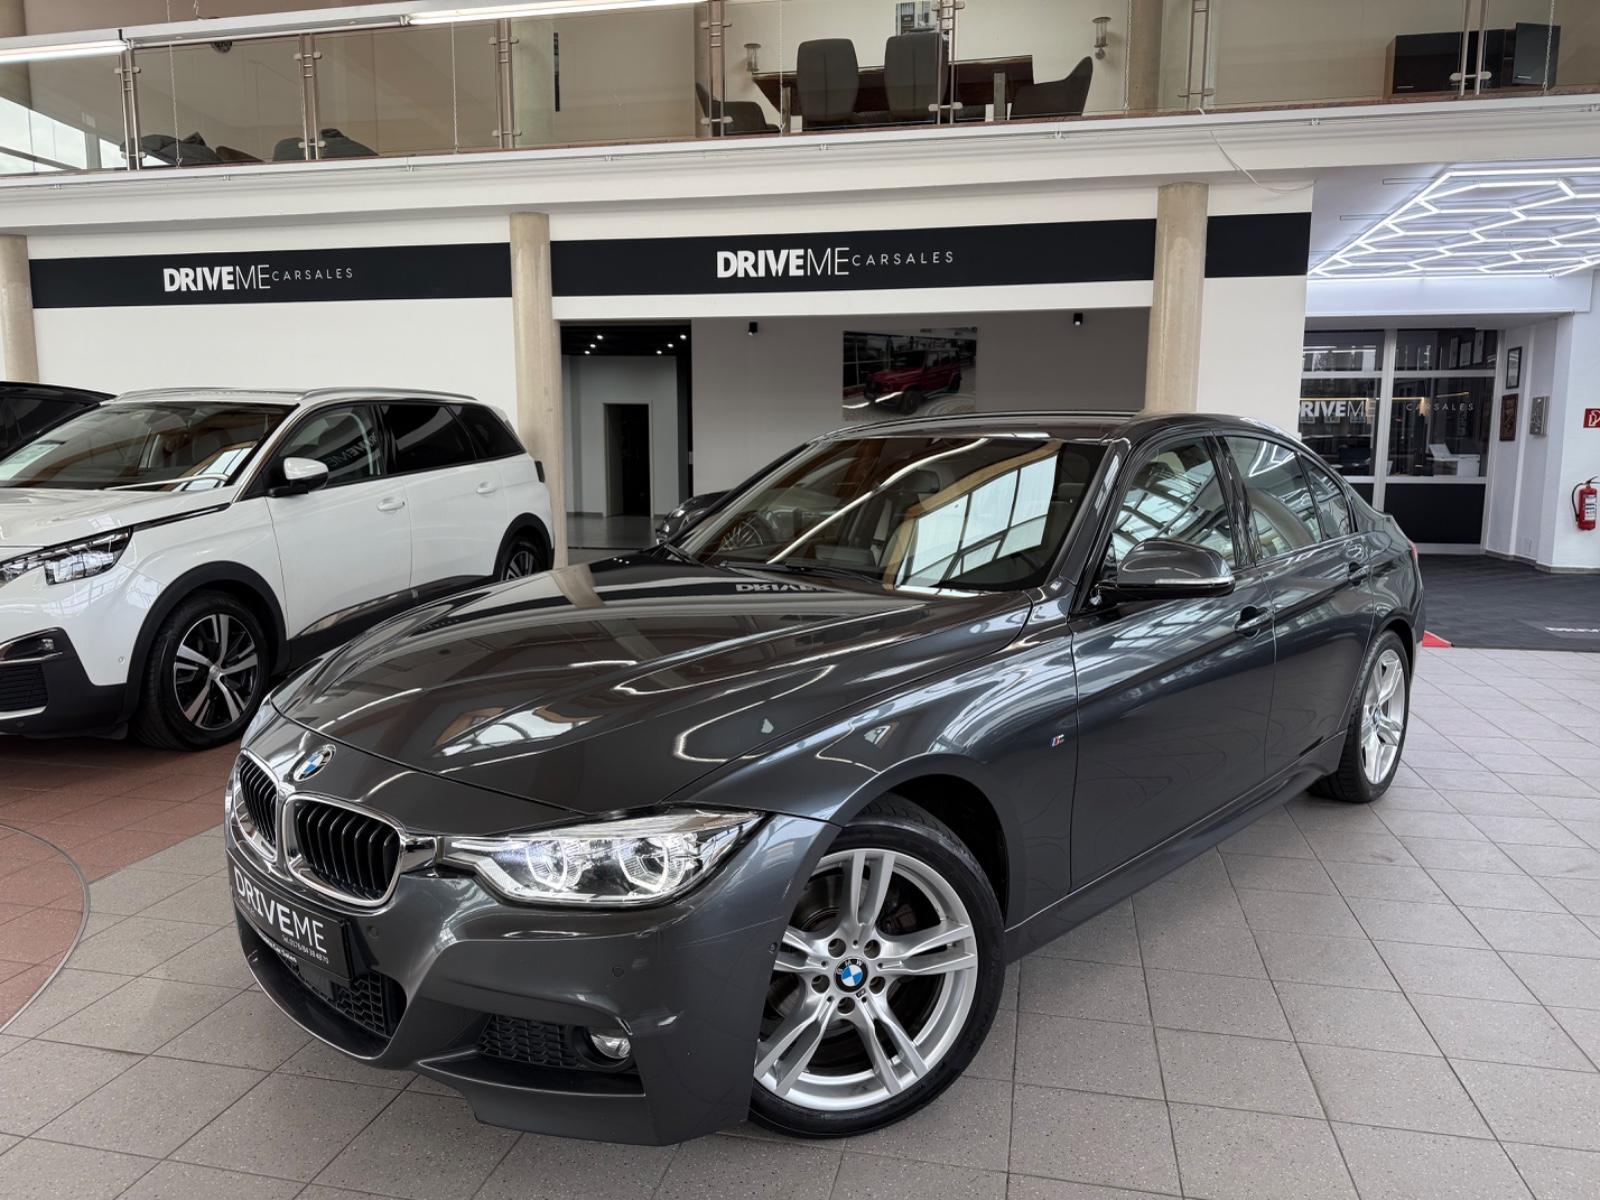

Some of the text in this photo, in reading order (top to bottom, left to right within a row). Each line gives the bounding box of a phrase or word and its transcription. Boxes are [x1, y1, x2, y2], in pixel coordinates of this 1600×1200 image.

[163, 264, 353, 292] DRIVEME CARSALES
[716, 247, 954, 278] DRIVEME CARSALES
[234, 865, 327, 954] DRIVEME
